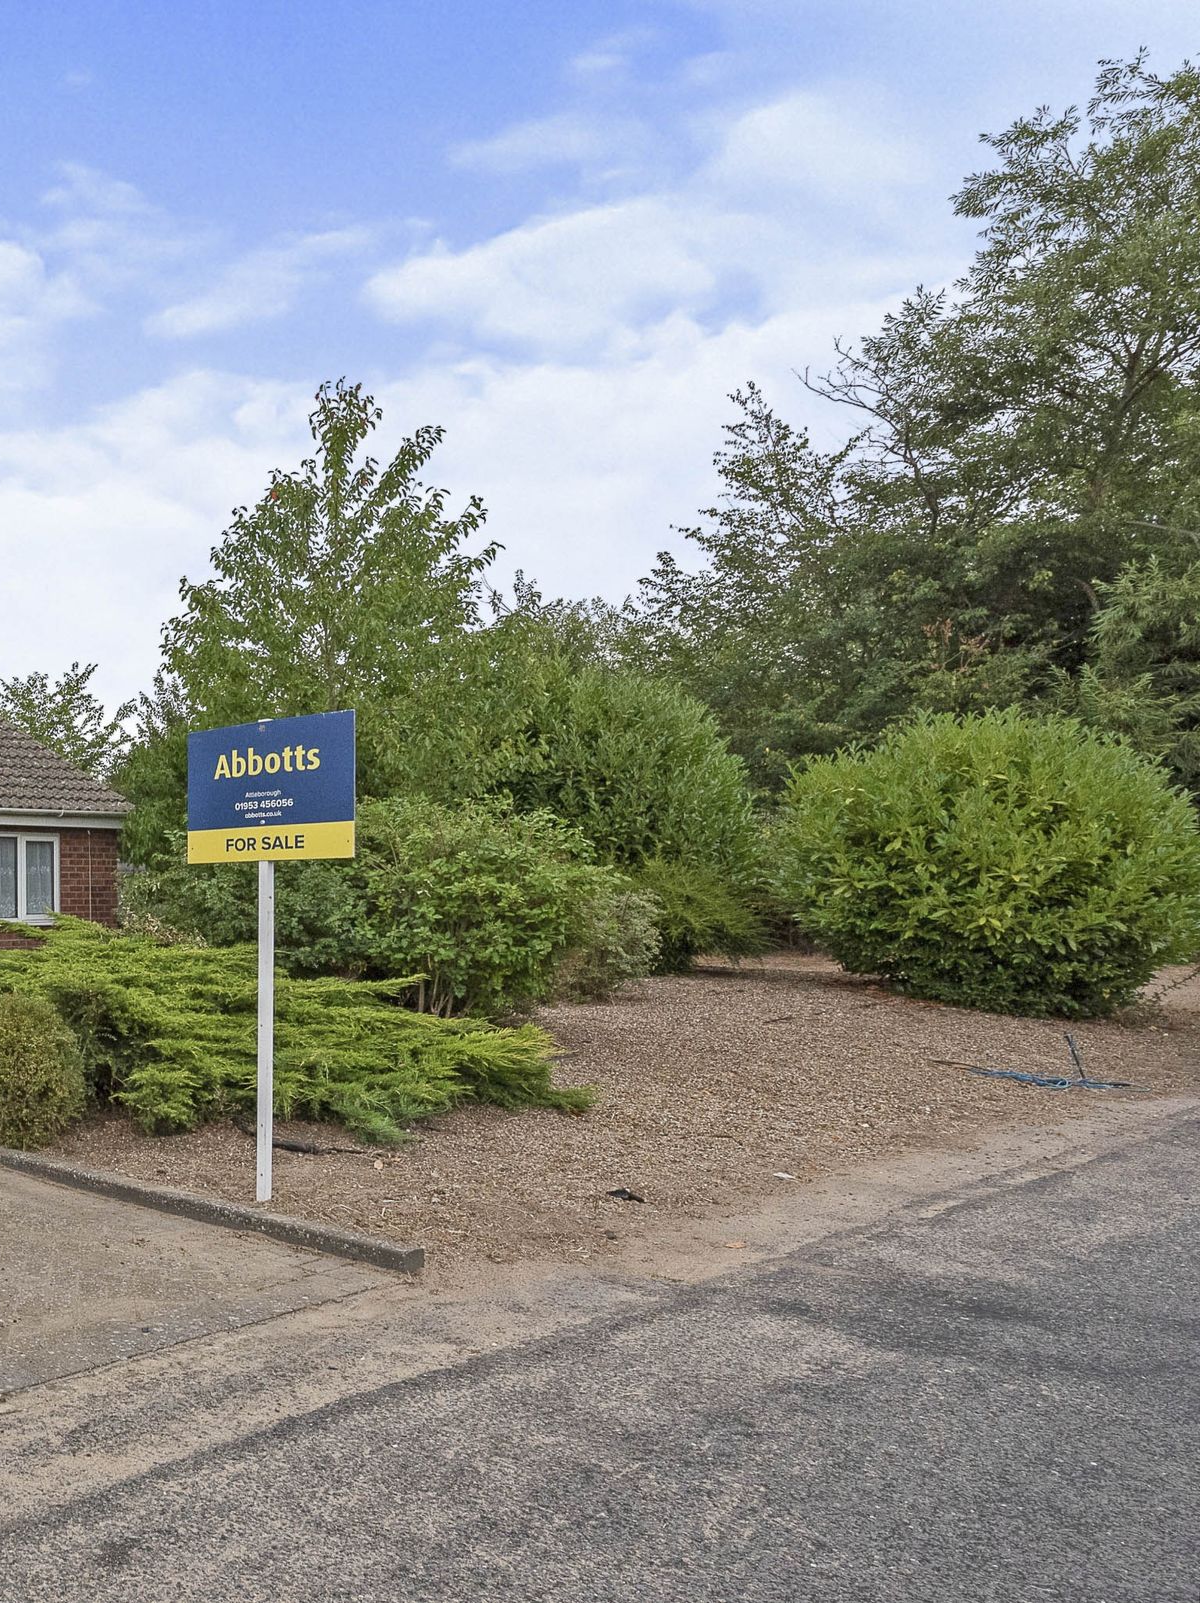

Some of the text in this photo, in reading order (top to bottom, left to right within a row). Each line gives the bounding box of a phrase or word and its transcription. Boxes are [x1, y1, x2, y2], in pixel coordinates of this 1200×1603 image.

[214, 745, 320, 780] Abbotts
[234, 798, 294, 811] 01953 456056
[225, 835, 305, 852] FOR SALE
